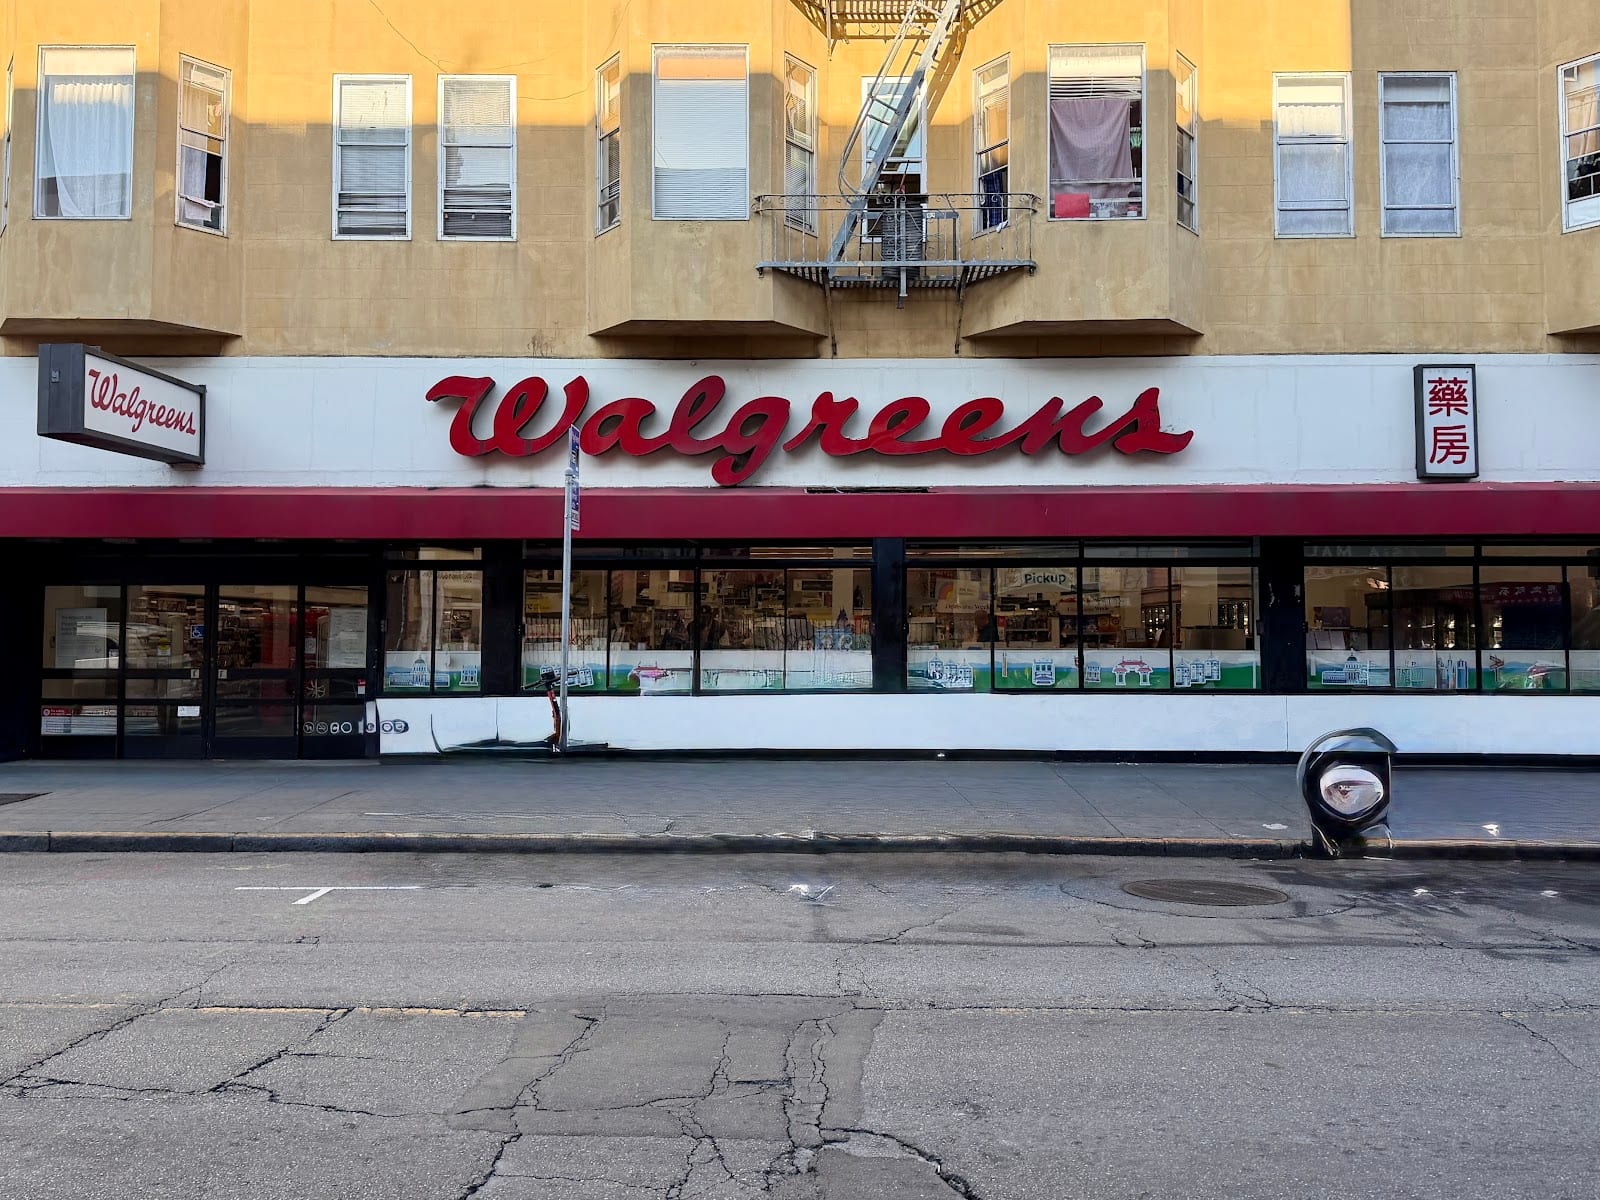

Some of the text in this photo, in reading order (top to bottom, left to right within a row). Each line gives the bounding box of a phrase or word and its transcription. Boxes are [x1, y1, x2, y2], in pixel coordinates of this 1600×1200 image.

[88, 369, 196, 436] Walgreens
[426, 375, 1194, 487] Walgreens
[1428, 377, 1470, 464] 藥房
[1024, 572, 1067, 585] Pickup
